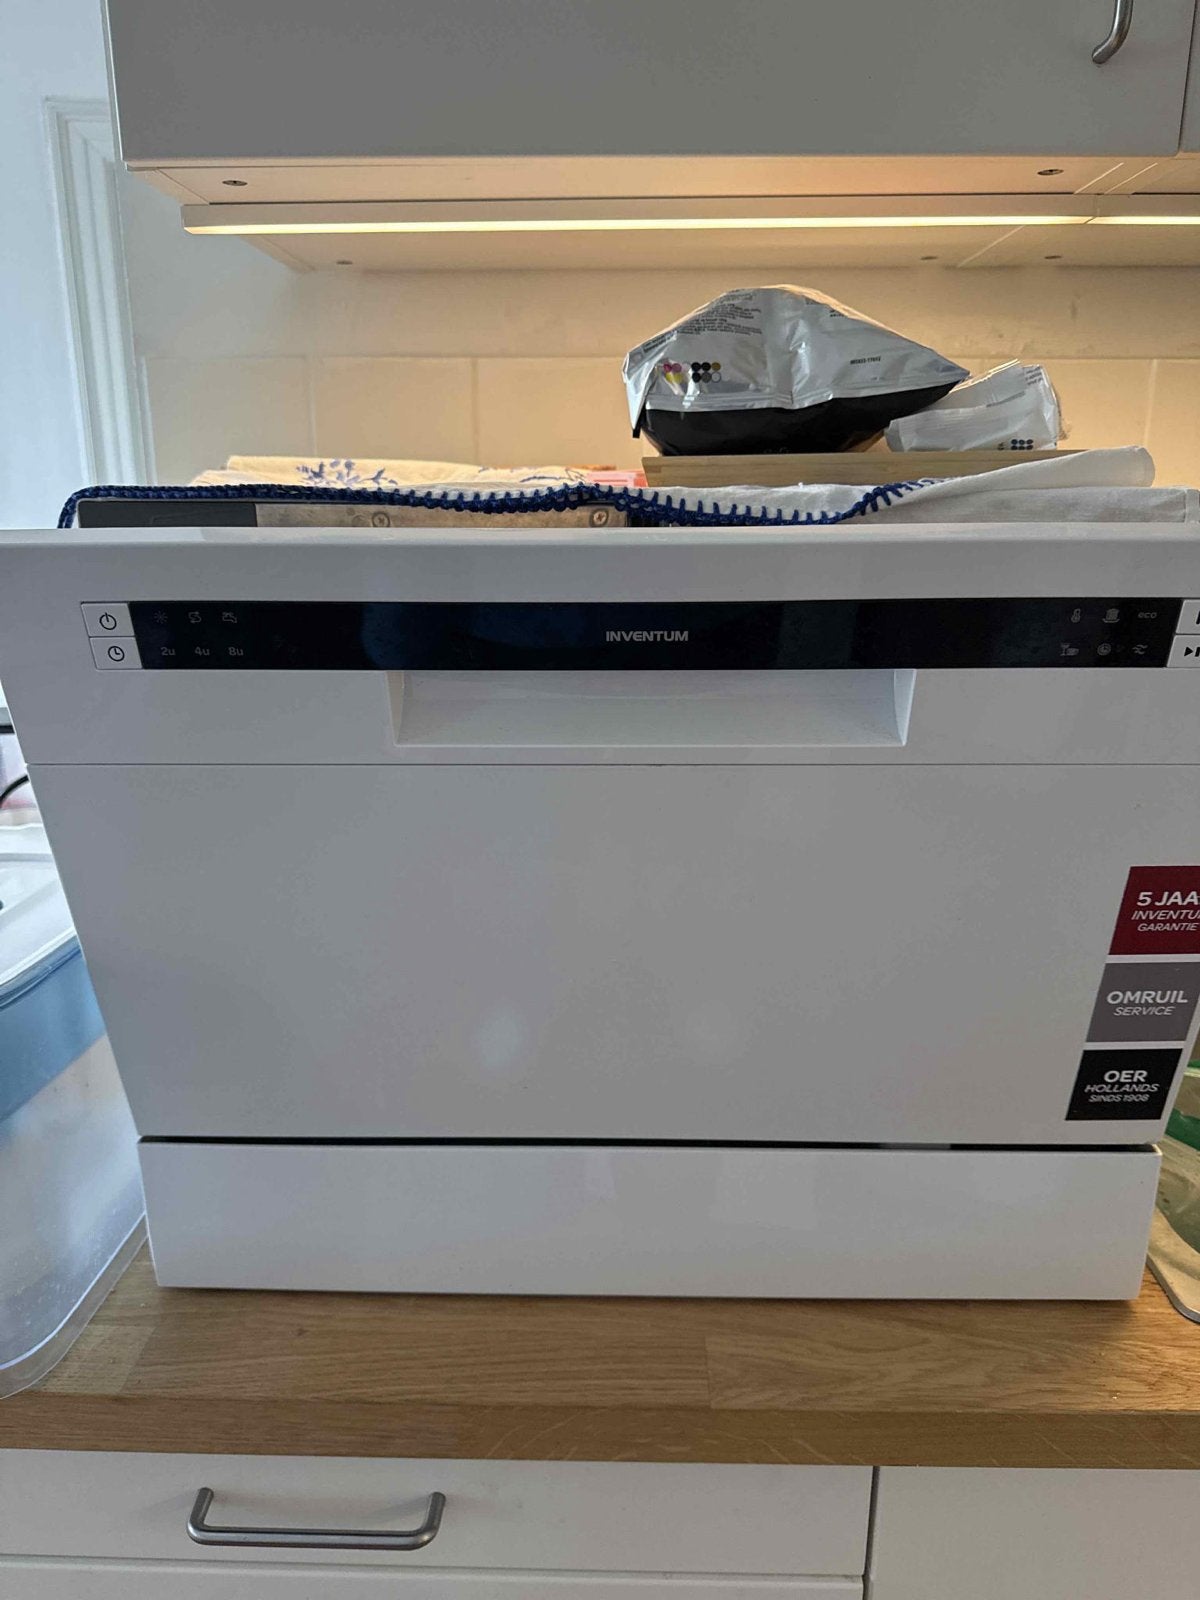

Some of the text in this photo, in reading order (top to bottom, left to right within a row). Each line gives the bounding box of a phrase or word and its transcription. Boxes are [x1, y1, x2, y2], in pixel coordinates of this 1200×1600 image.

[1137, 611, 1158, 619] eco
[606, 631, 689, 642] INVENTUM
[160, 646, 244, 656] 2u 4u 8u
[1136, 891, 1200, 906] 5 JAA
[1131, 910, 1200, 920] INVENTU
[1137, 922, 1199, 932] GARANTIE
[1106, 990, 1188, 1005] OMRUIL
[1113, 1006, 1175, 1016] SERVICE
[1103, 1070, 1148, 1083] OER
[1084, 1083, 1159, 1093] HOLLANDS
[1088, 1093, 1150, 1103] SINDS 1908
